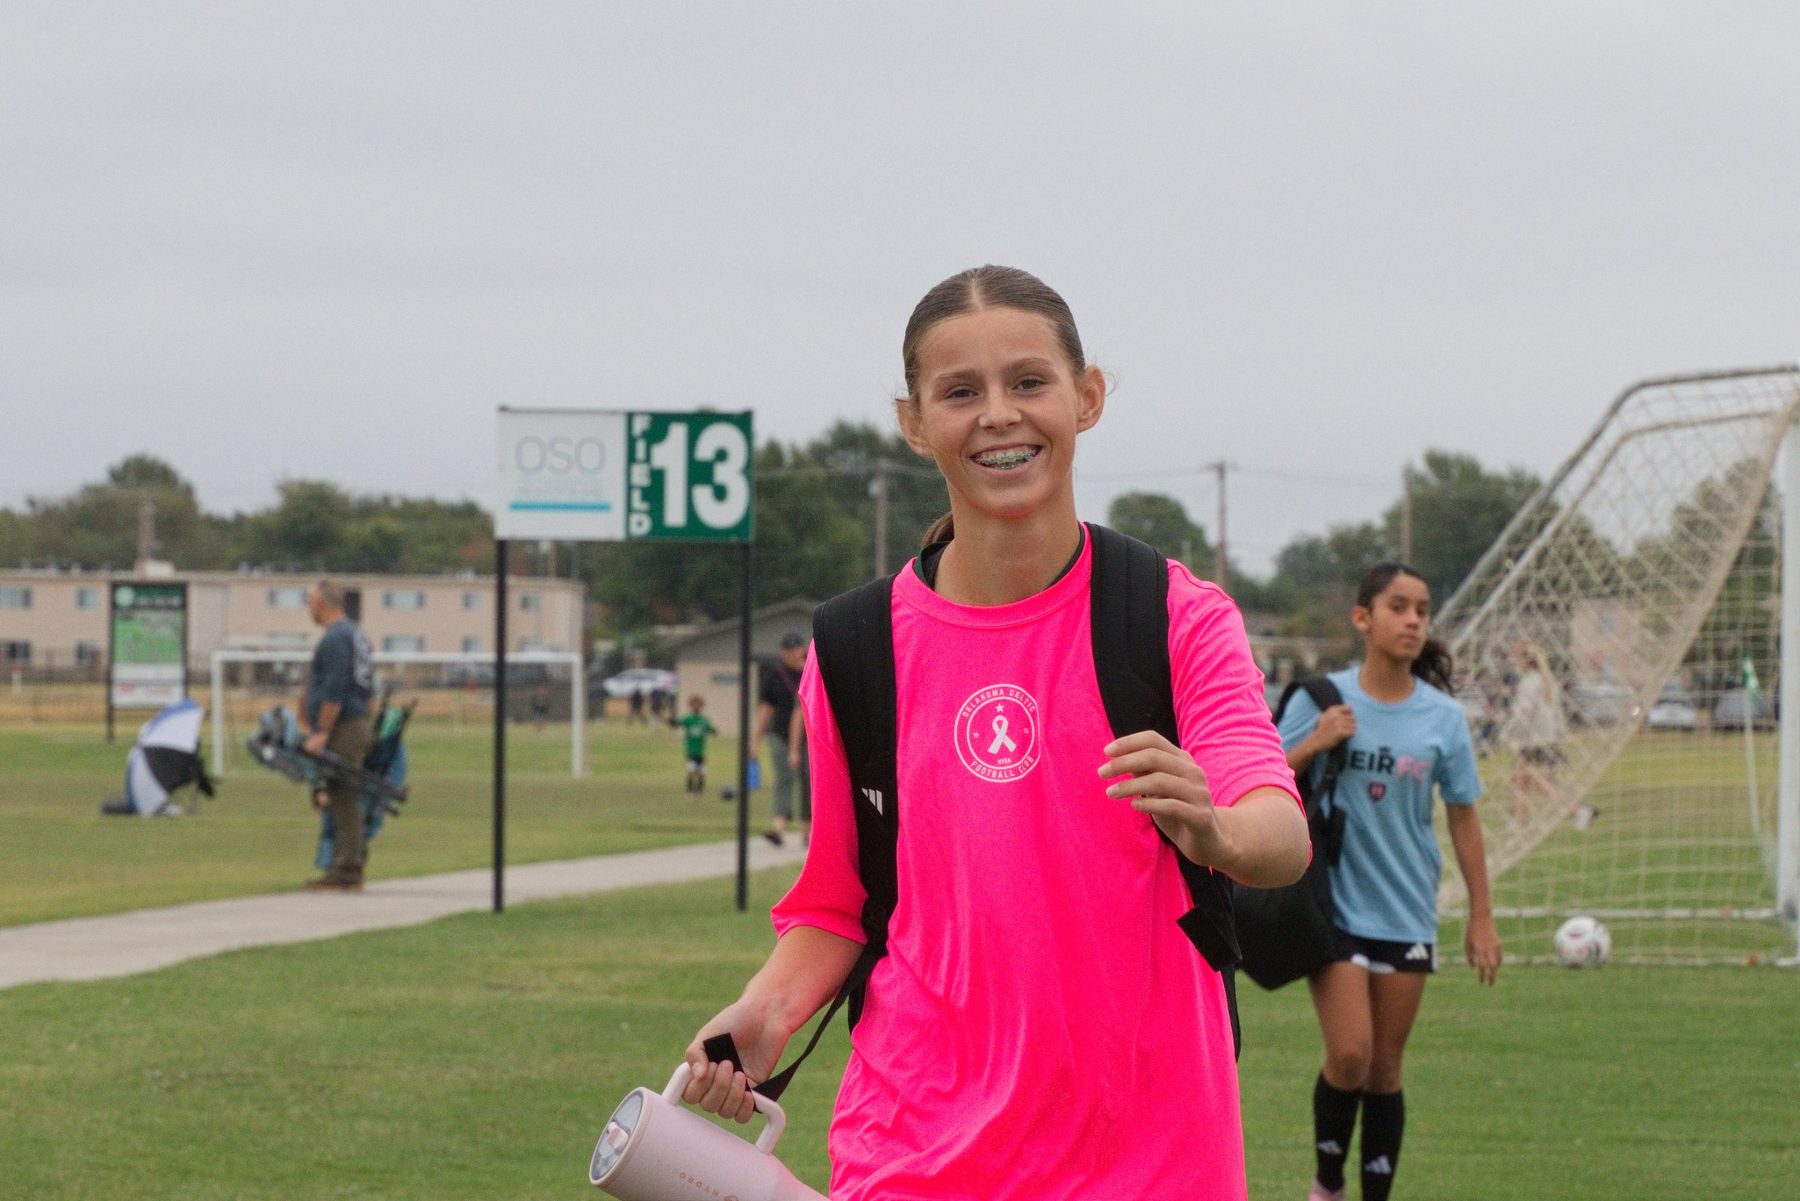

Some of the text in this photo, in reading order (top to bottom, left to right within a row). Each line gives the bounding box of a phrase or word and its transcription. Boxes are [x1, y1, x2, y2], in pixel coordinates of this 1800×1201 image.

[515, 436, 606, 475] OSO
[651, 421, 750, 529] 13
[629, 414, 652, 537] FIELD
[962, 688, 1036, 718] OKLAHOMA CELTIC
[970, 755, 1034, 778] FOOTBALL CLUB
